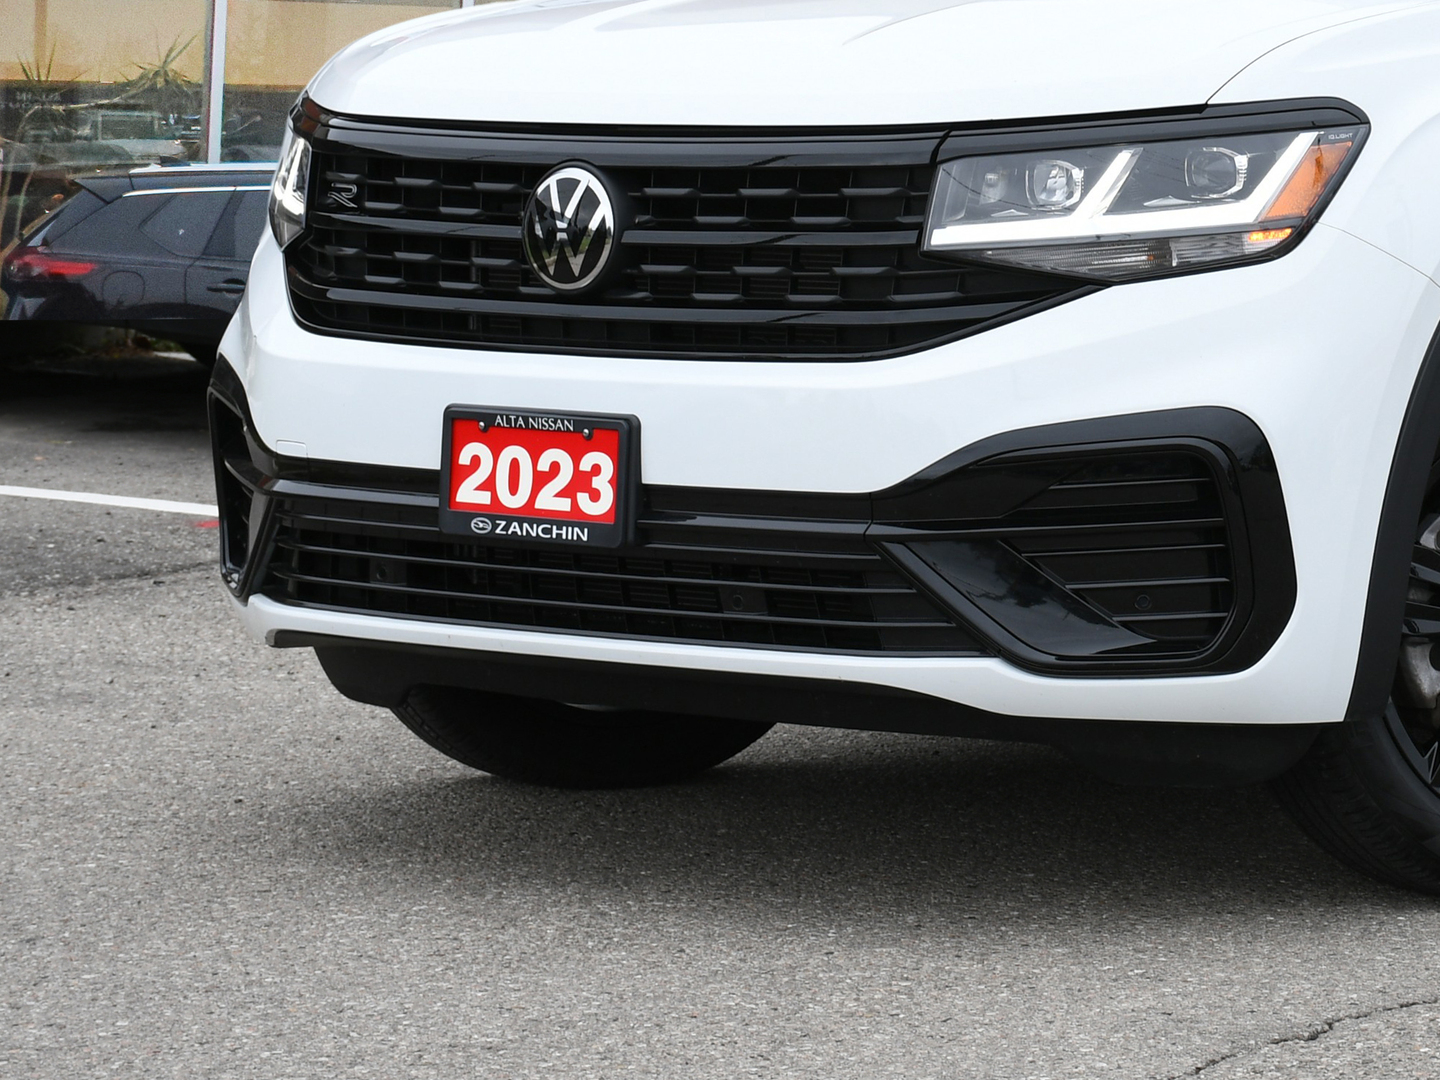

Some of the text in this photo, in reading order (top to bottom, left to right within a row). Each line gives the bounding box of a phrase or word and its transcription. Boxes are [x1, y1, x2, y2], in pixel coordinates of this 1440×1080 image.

[494, 414, 574, 432] ALTA NISSAN
[455, 441, 614, 516] 2023
[494, 520, 588, 542] ZANCHIN
